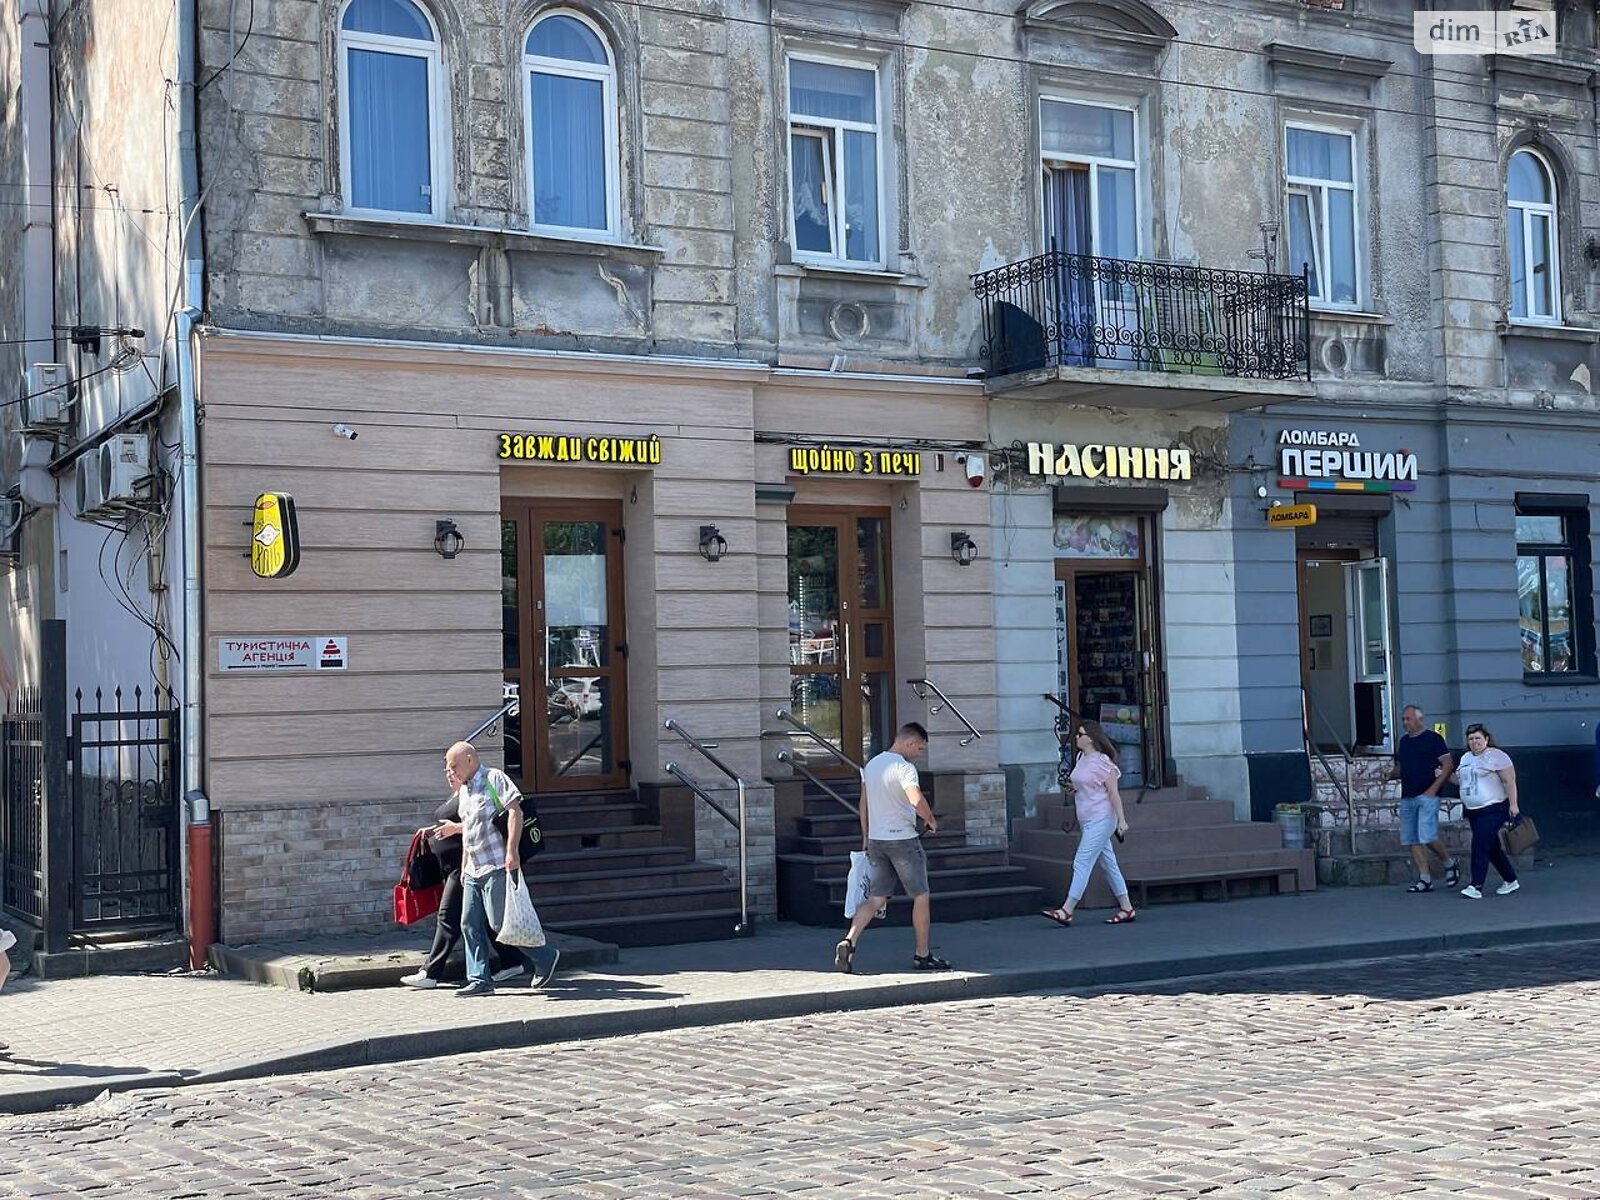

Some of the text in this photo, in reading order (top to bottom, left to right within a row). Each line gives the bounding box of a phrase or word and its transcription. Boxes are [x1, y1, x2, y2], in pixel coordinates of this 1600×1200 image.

[1279, 429, 1360, 447] ЛОМБАРД
[1026, 442, 1192, 480] НАСІННЯ
[1281, 448, 1418, 481] ПЕРШИЙ
[1270, 510, 1310, 522] ЛОМБАРД
[225, 641, 311, 651] ТУРИСТИЧНА
[242, 652, 295, 662] АГЕНЦІЯ
